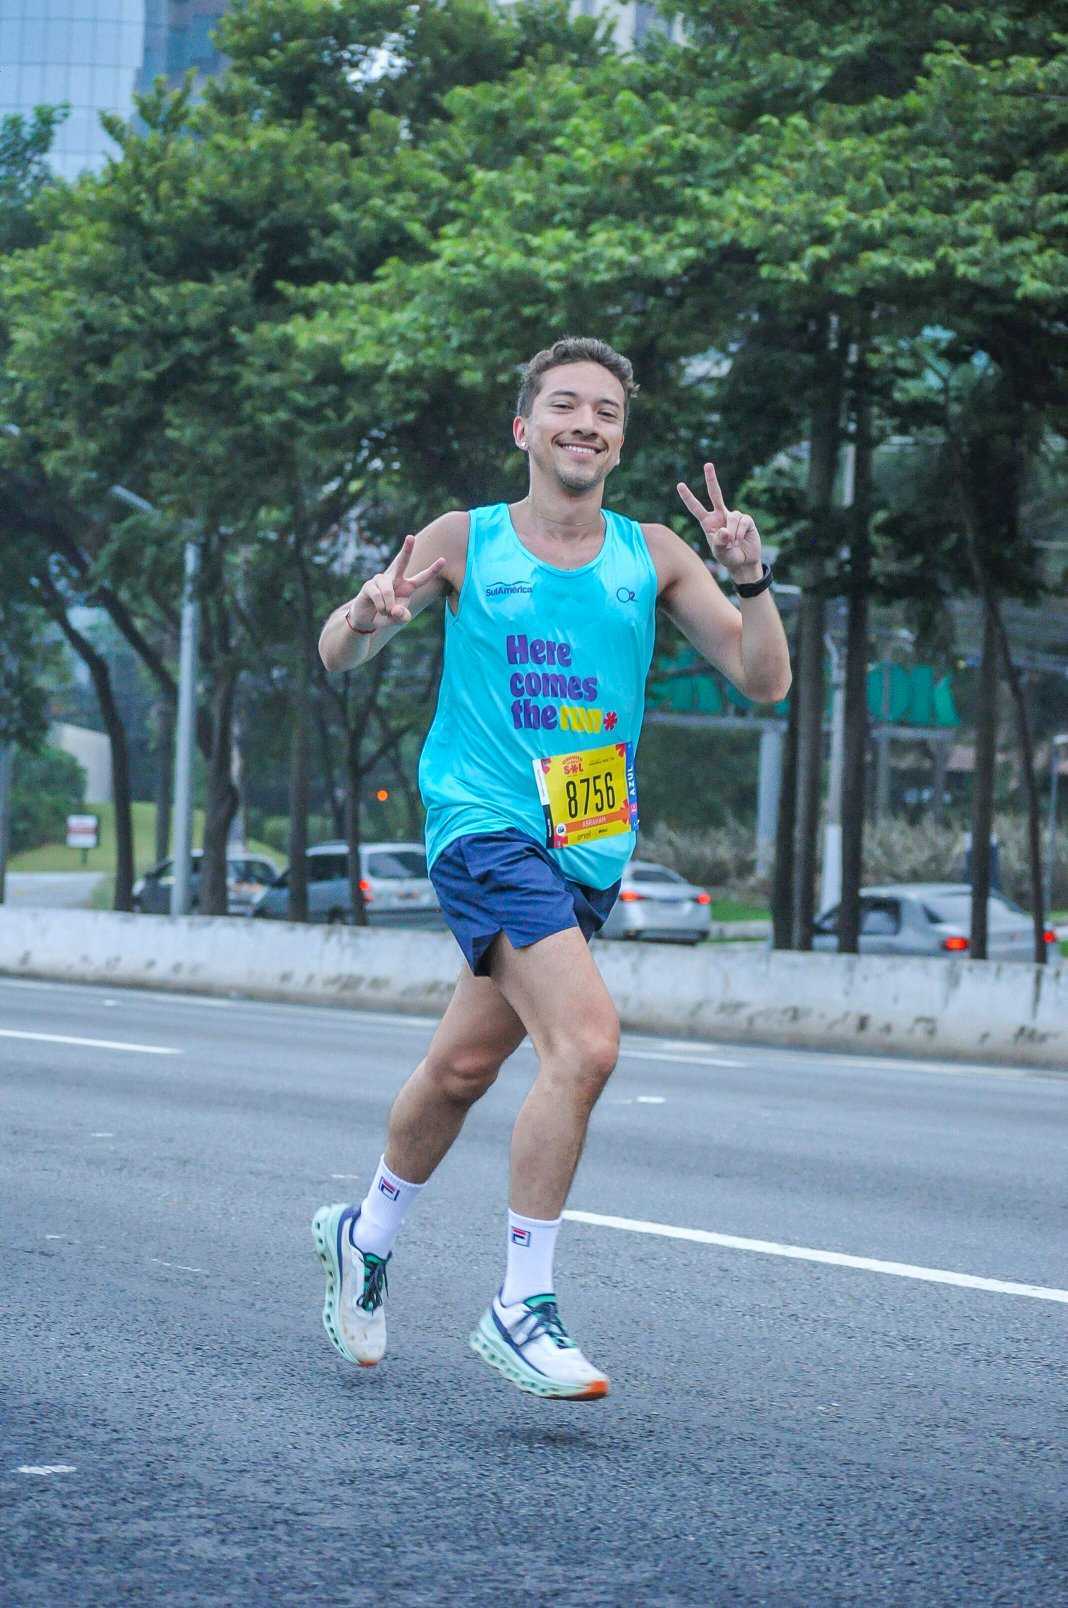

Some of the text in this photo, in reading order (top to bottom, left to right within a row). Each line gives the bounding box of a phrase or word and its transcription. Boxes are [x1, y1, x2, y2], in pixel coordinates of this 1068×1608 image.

[506, 634, 572, 668] Here
[509, 672, 598, 703] comes
[510, 698, 558, 730] the
[565, 771, 616, 819] 8756
[626, 767, 637, 796] AZUL
